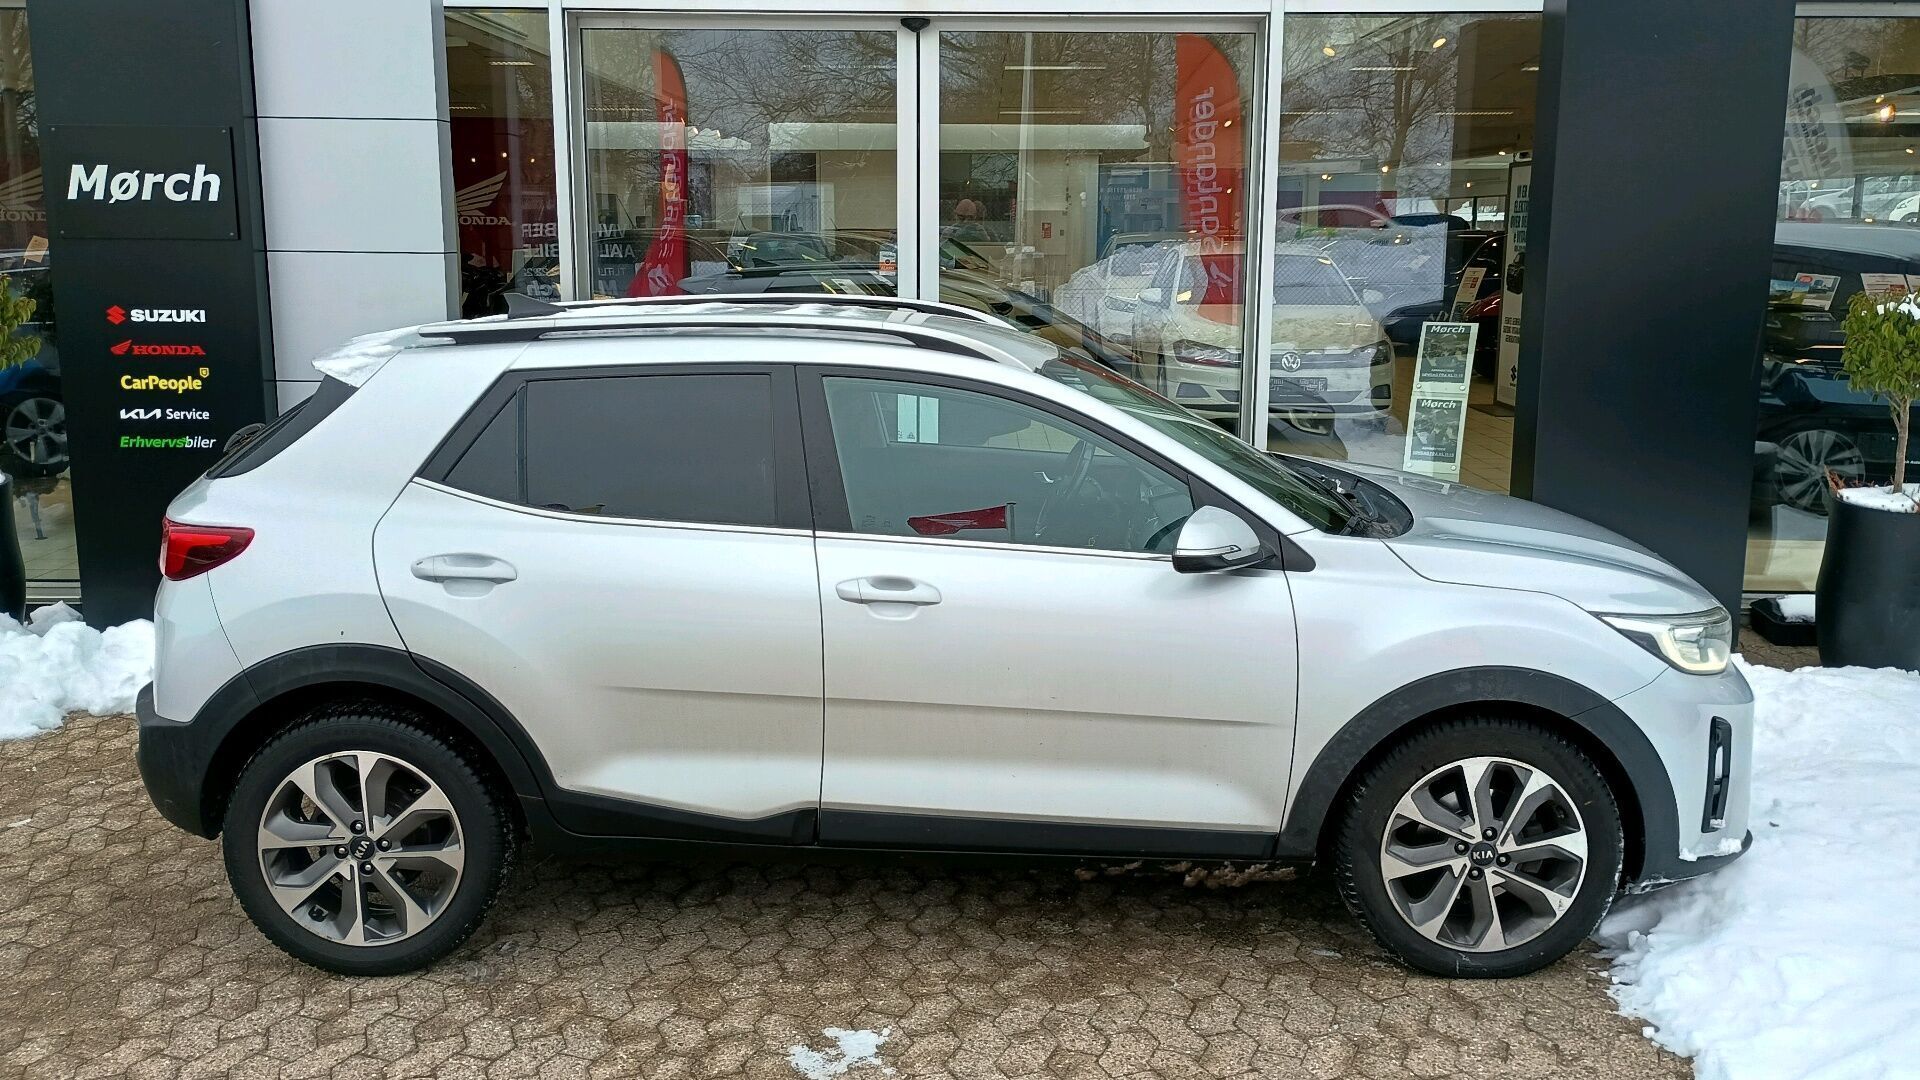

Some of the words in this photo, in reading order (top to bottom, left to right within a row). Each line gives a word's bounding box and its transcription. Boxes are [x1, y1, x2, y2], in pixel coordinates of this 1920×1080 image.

[67, 163, 222, 204] Mørch
[457, 216, 512, 226] ONDA
[130, 309, 206, 322] SUZUKI
[1430, 325, 1466, 334] Mørch
[132, 345, 206, 355] HONDA
[120, 375, 202, 394] CarPeople
[165, 408, 210, 420] Service
[120, 436, 217, 448] Erhvervsbiler
[355, 840, 370, 858] KIA
[1473, 850, 1493, 860] KIA
